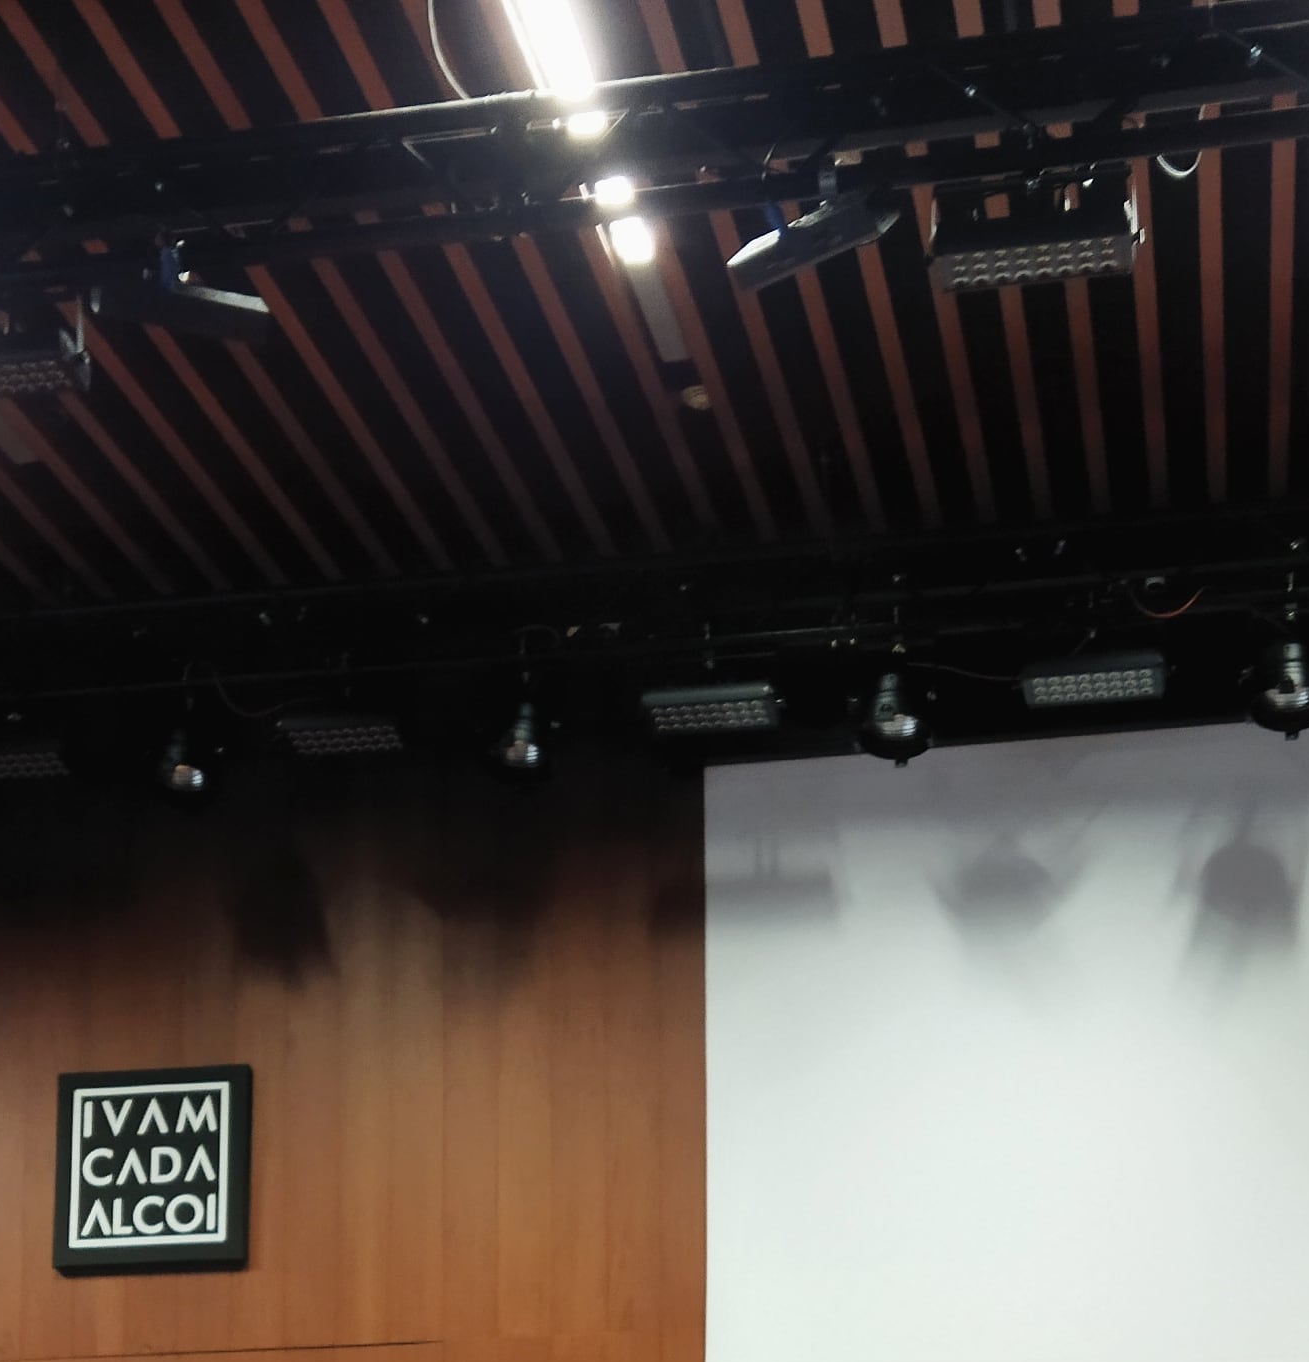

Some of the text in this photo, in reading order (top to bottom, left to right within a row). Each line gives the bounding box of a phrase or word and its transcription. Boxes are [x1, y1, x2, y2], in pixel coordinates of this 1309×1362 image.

[83, 1094, 218, 1139] IVAM
[82, 1143, 217, 1187] CADA
[80, 1192, 218, 1237] ALCOI
